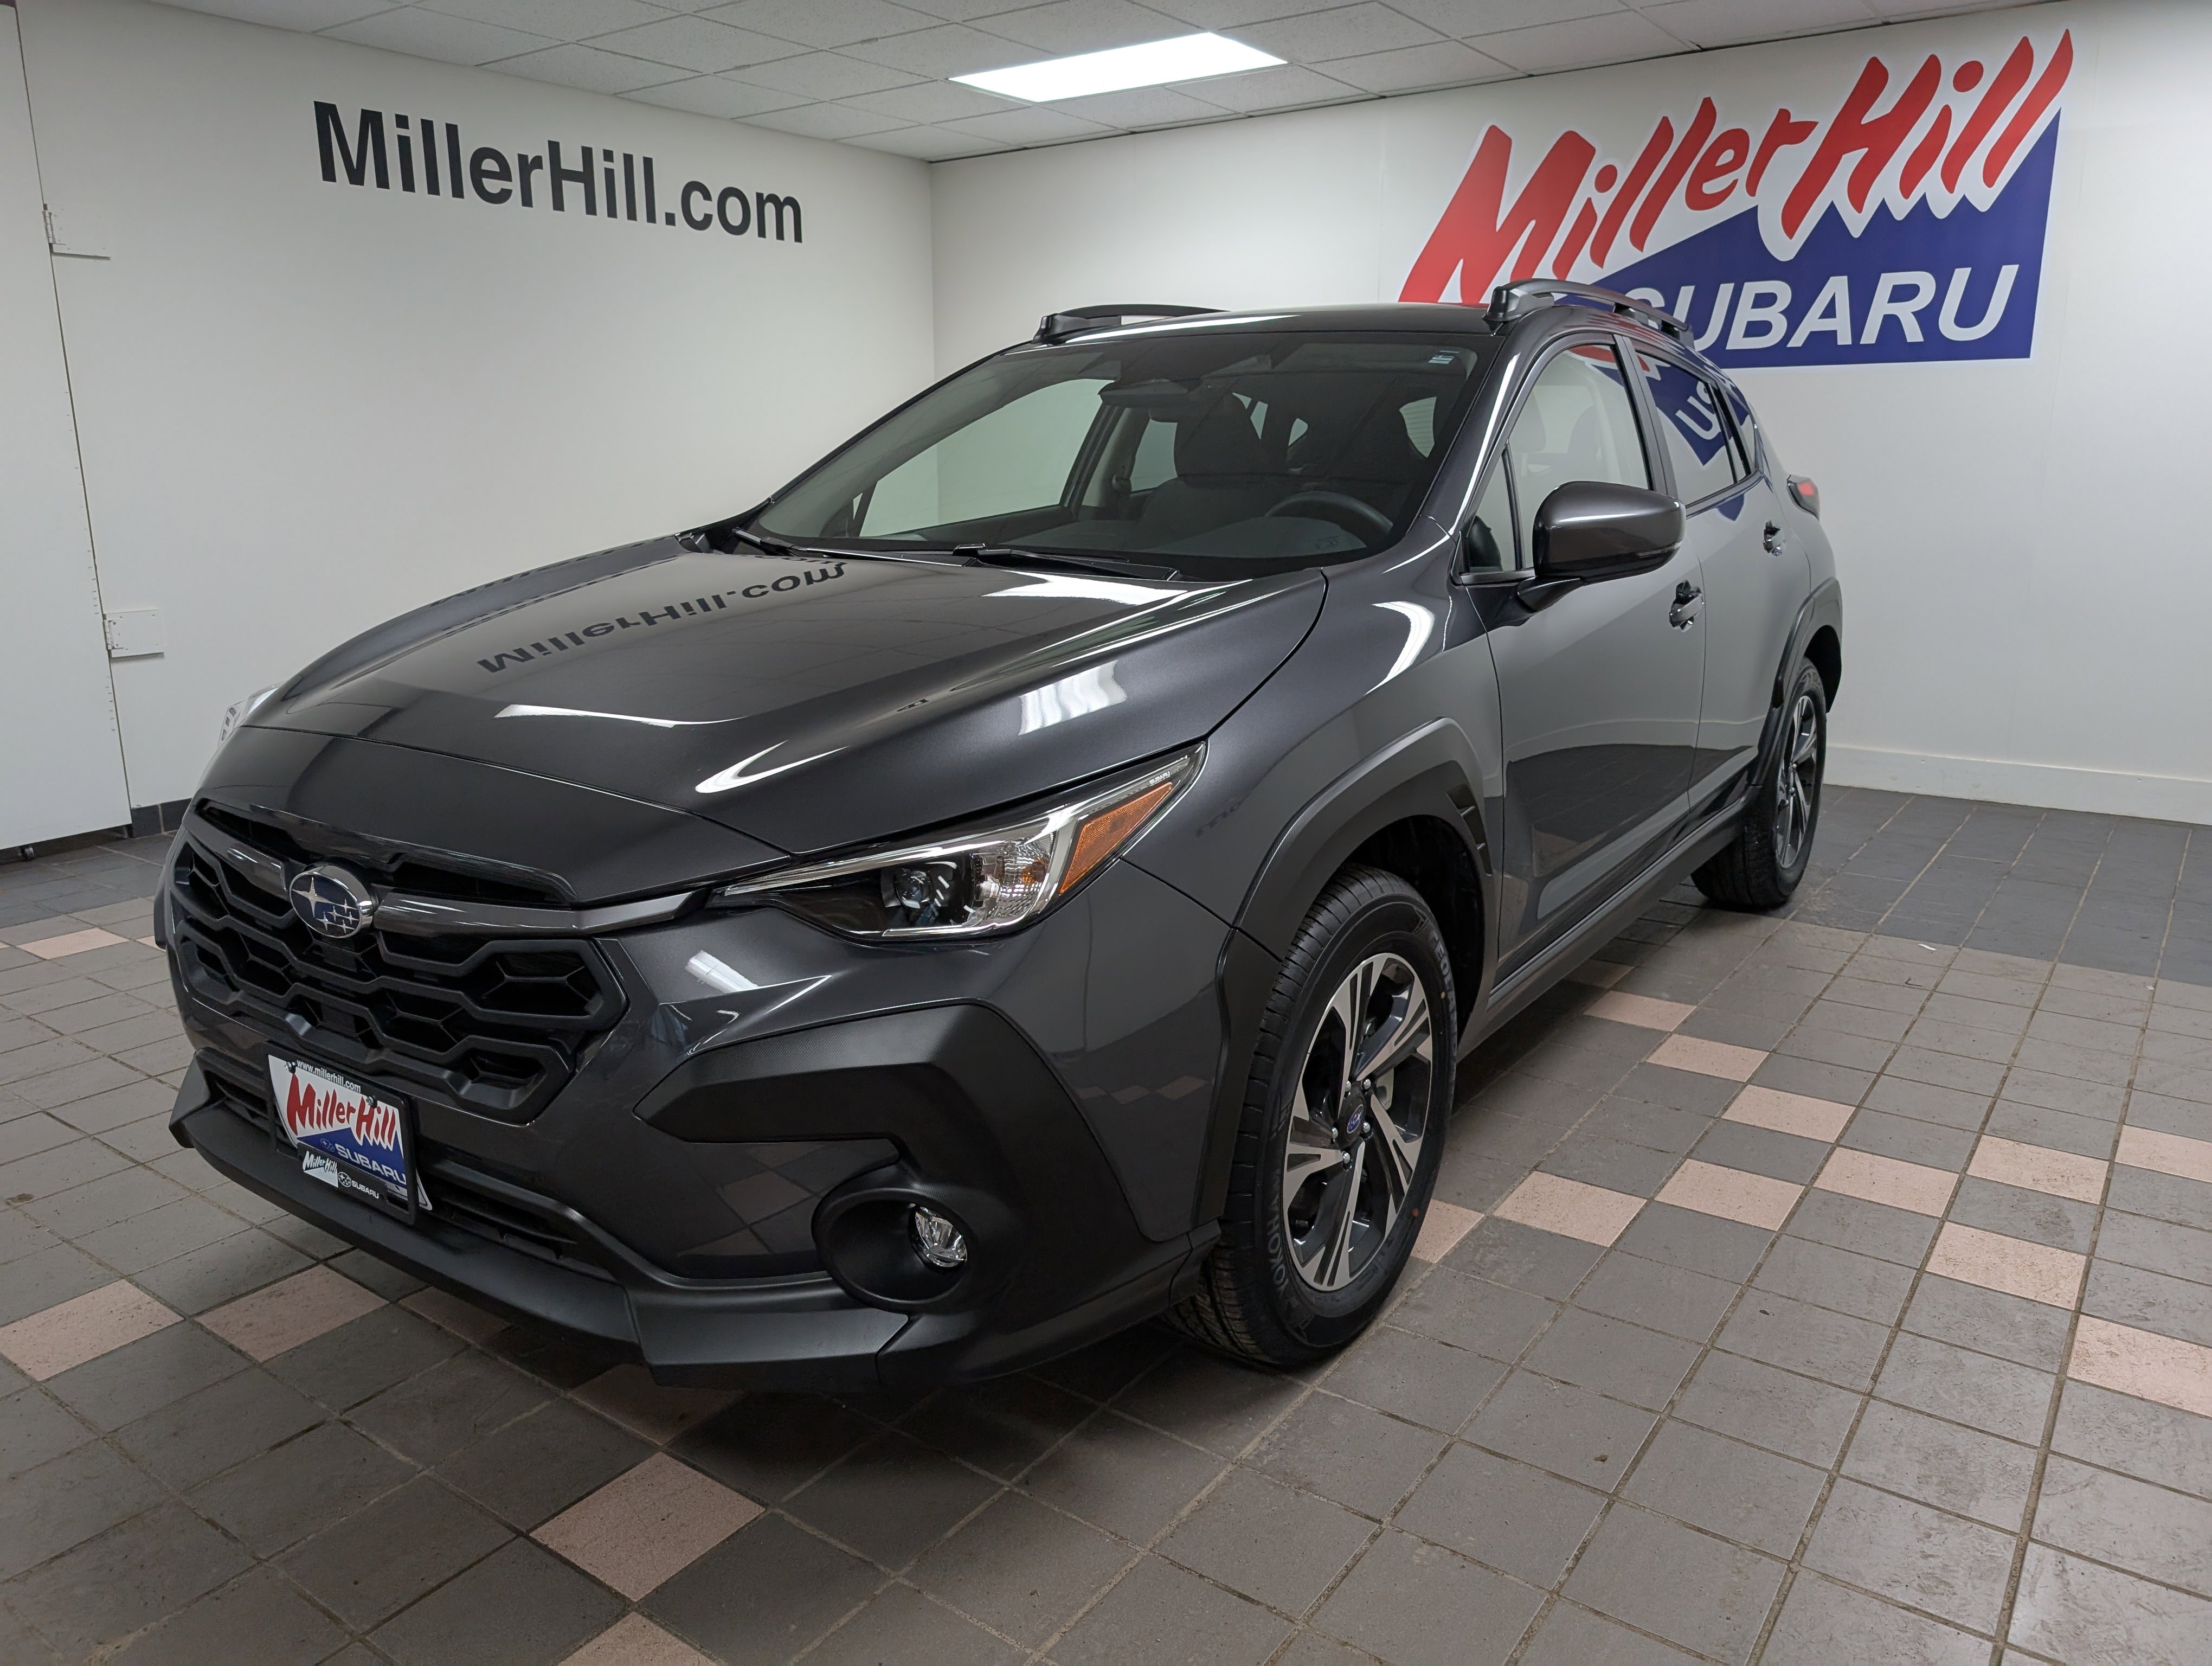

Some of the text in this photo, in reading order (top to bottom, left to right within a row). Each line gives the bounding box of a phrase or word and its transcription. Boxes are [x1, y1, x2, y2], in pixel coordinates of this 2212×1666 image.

[314, 101, 802, 243] MillerHill.com
[1149, 771, 1171, 784] SUBARU
[297, 1060, 361, 1093] www.millerhill.com
[335, 1143, 407, 1186] SUBARU
[352, 1180, 379, 1199] SUBARU
